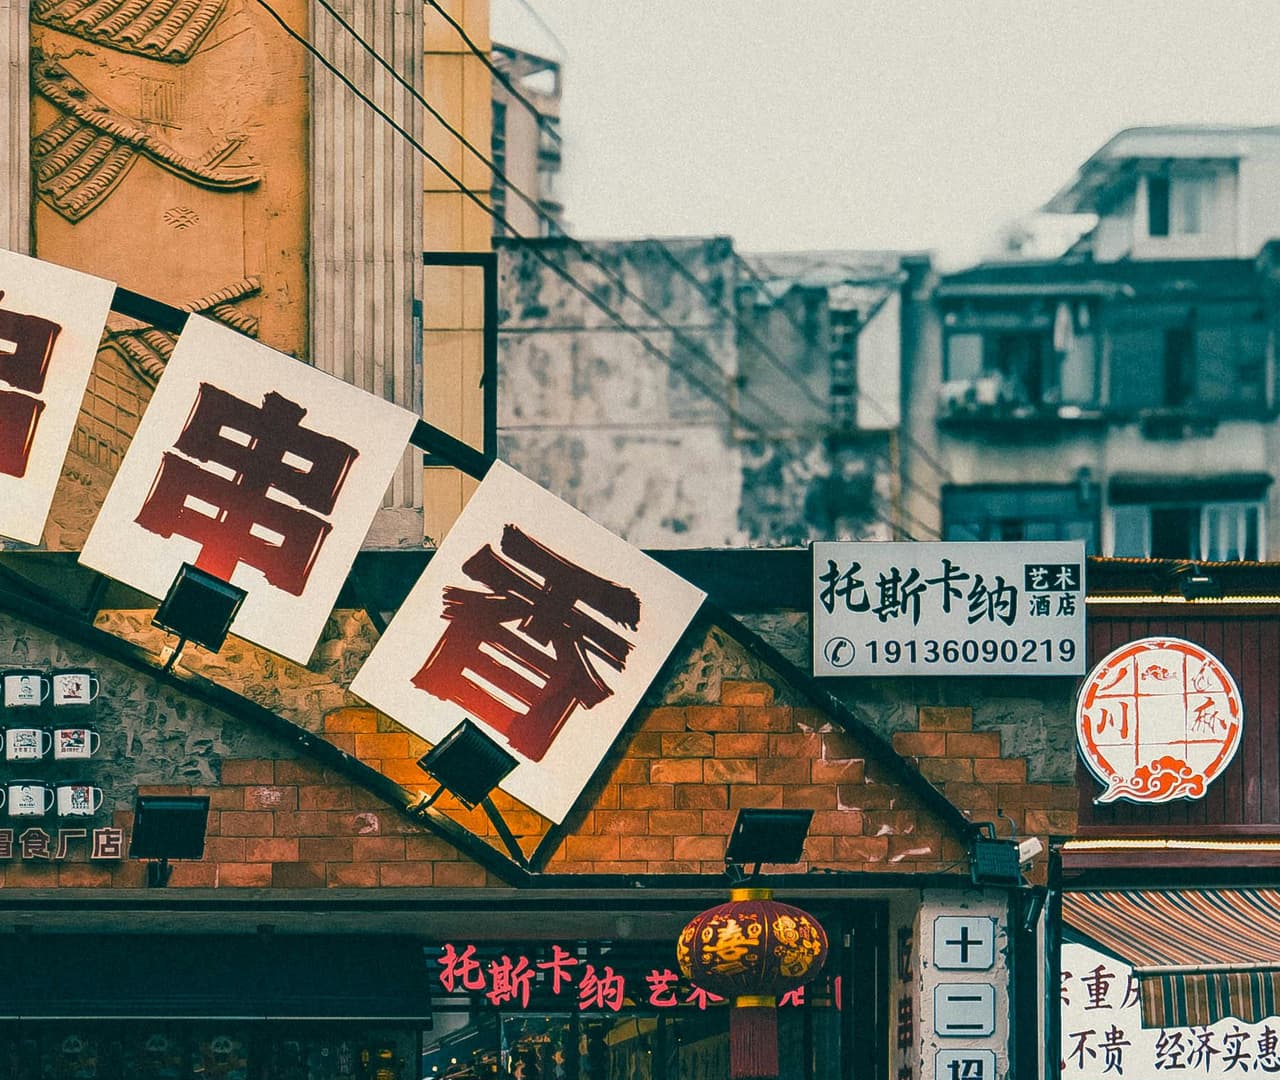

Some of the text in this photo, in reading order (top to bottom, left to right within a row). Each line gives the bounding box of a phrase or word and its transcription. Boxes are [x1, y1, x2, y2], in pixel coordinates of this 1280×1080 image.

[818, 558, 1019, 627] 托斯卡纳
[1029, 567, 1078, 591] 艺术
[1028, 593, 1078, 618] 酒店
[864, 637, 1077, 664] 19136090219
[437, 944, 627, 1012] 托斯卡纳
[1061, 1023, 1280, 1076] 不贵 经济实惠
